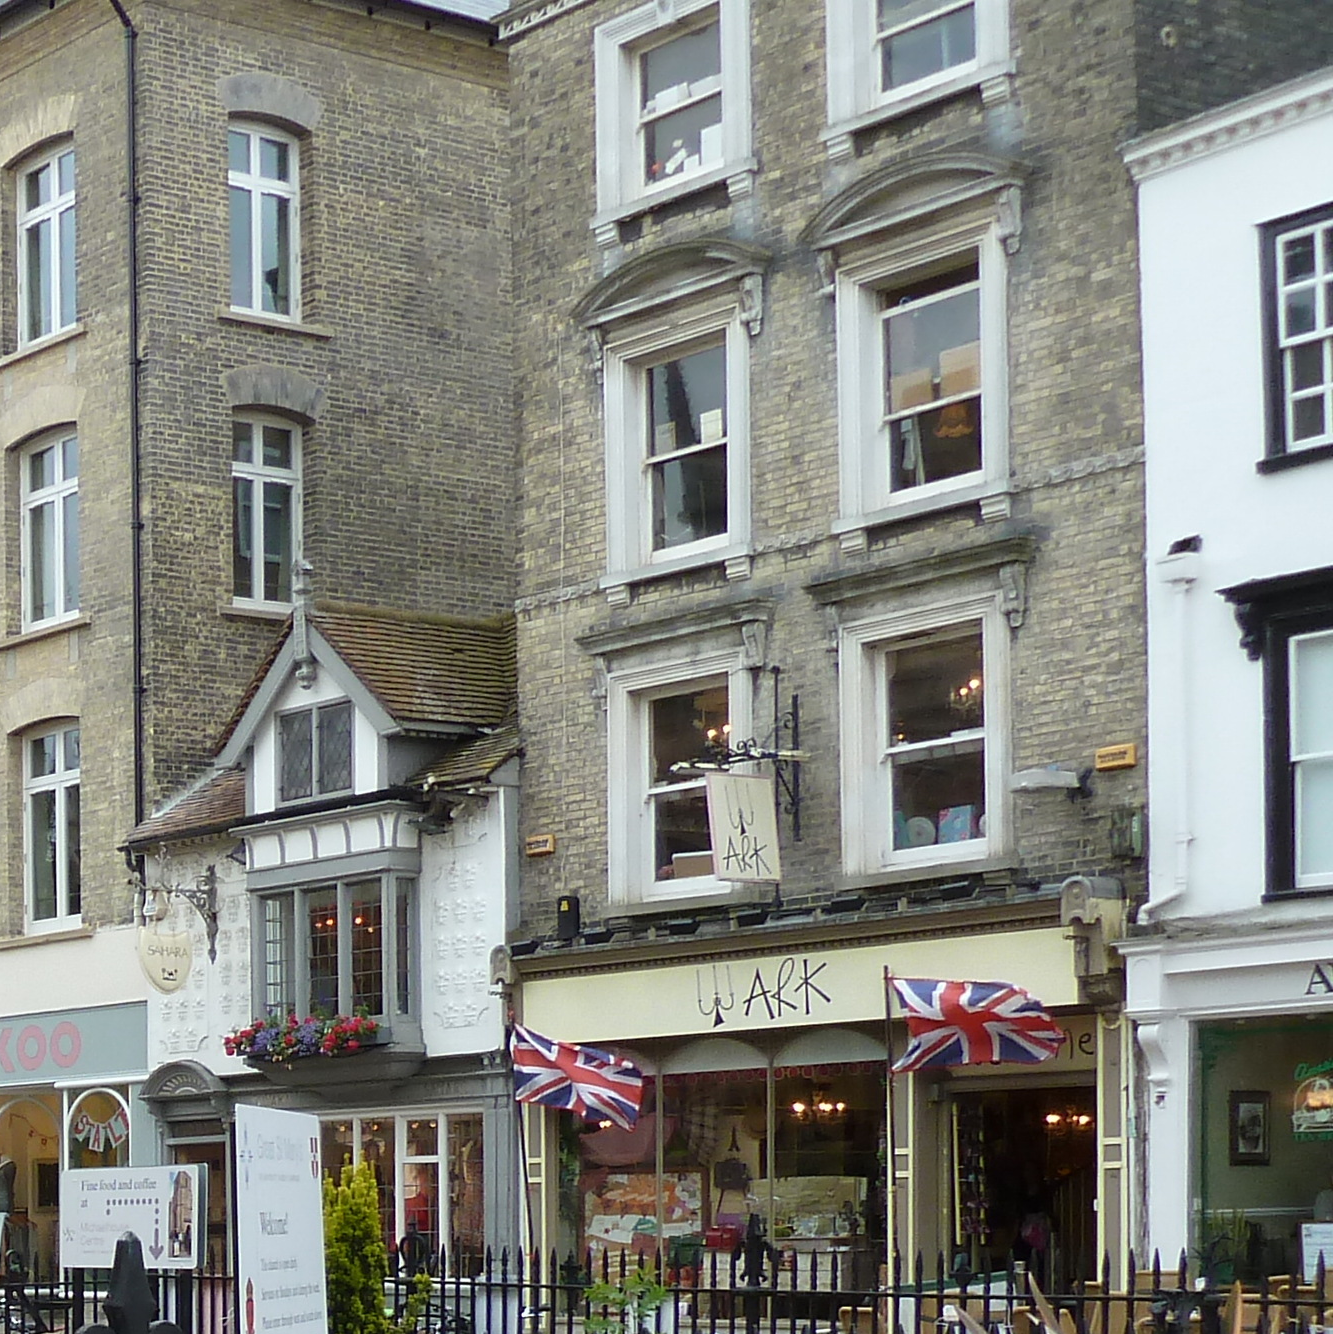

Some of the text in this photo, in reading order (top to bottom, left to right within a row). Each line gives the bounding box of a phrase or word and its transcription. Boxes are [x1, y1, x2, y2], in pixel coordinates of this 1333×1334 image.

[722, 835, 772, 877] ARK
[147, 944, 189, 958] SAHARA
[743, 957, 832, 1021] ARK
[80, 1178, 157, 1192] Fine food and coffee
